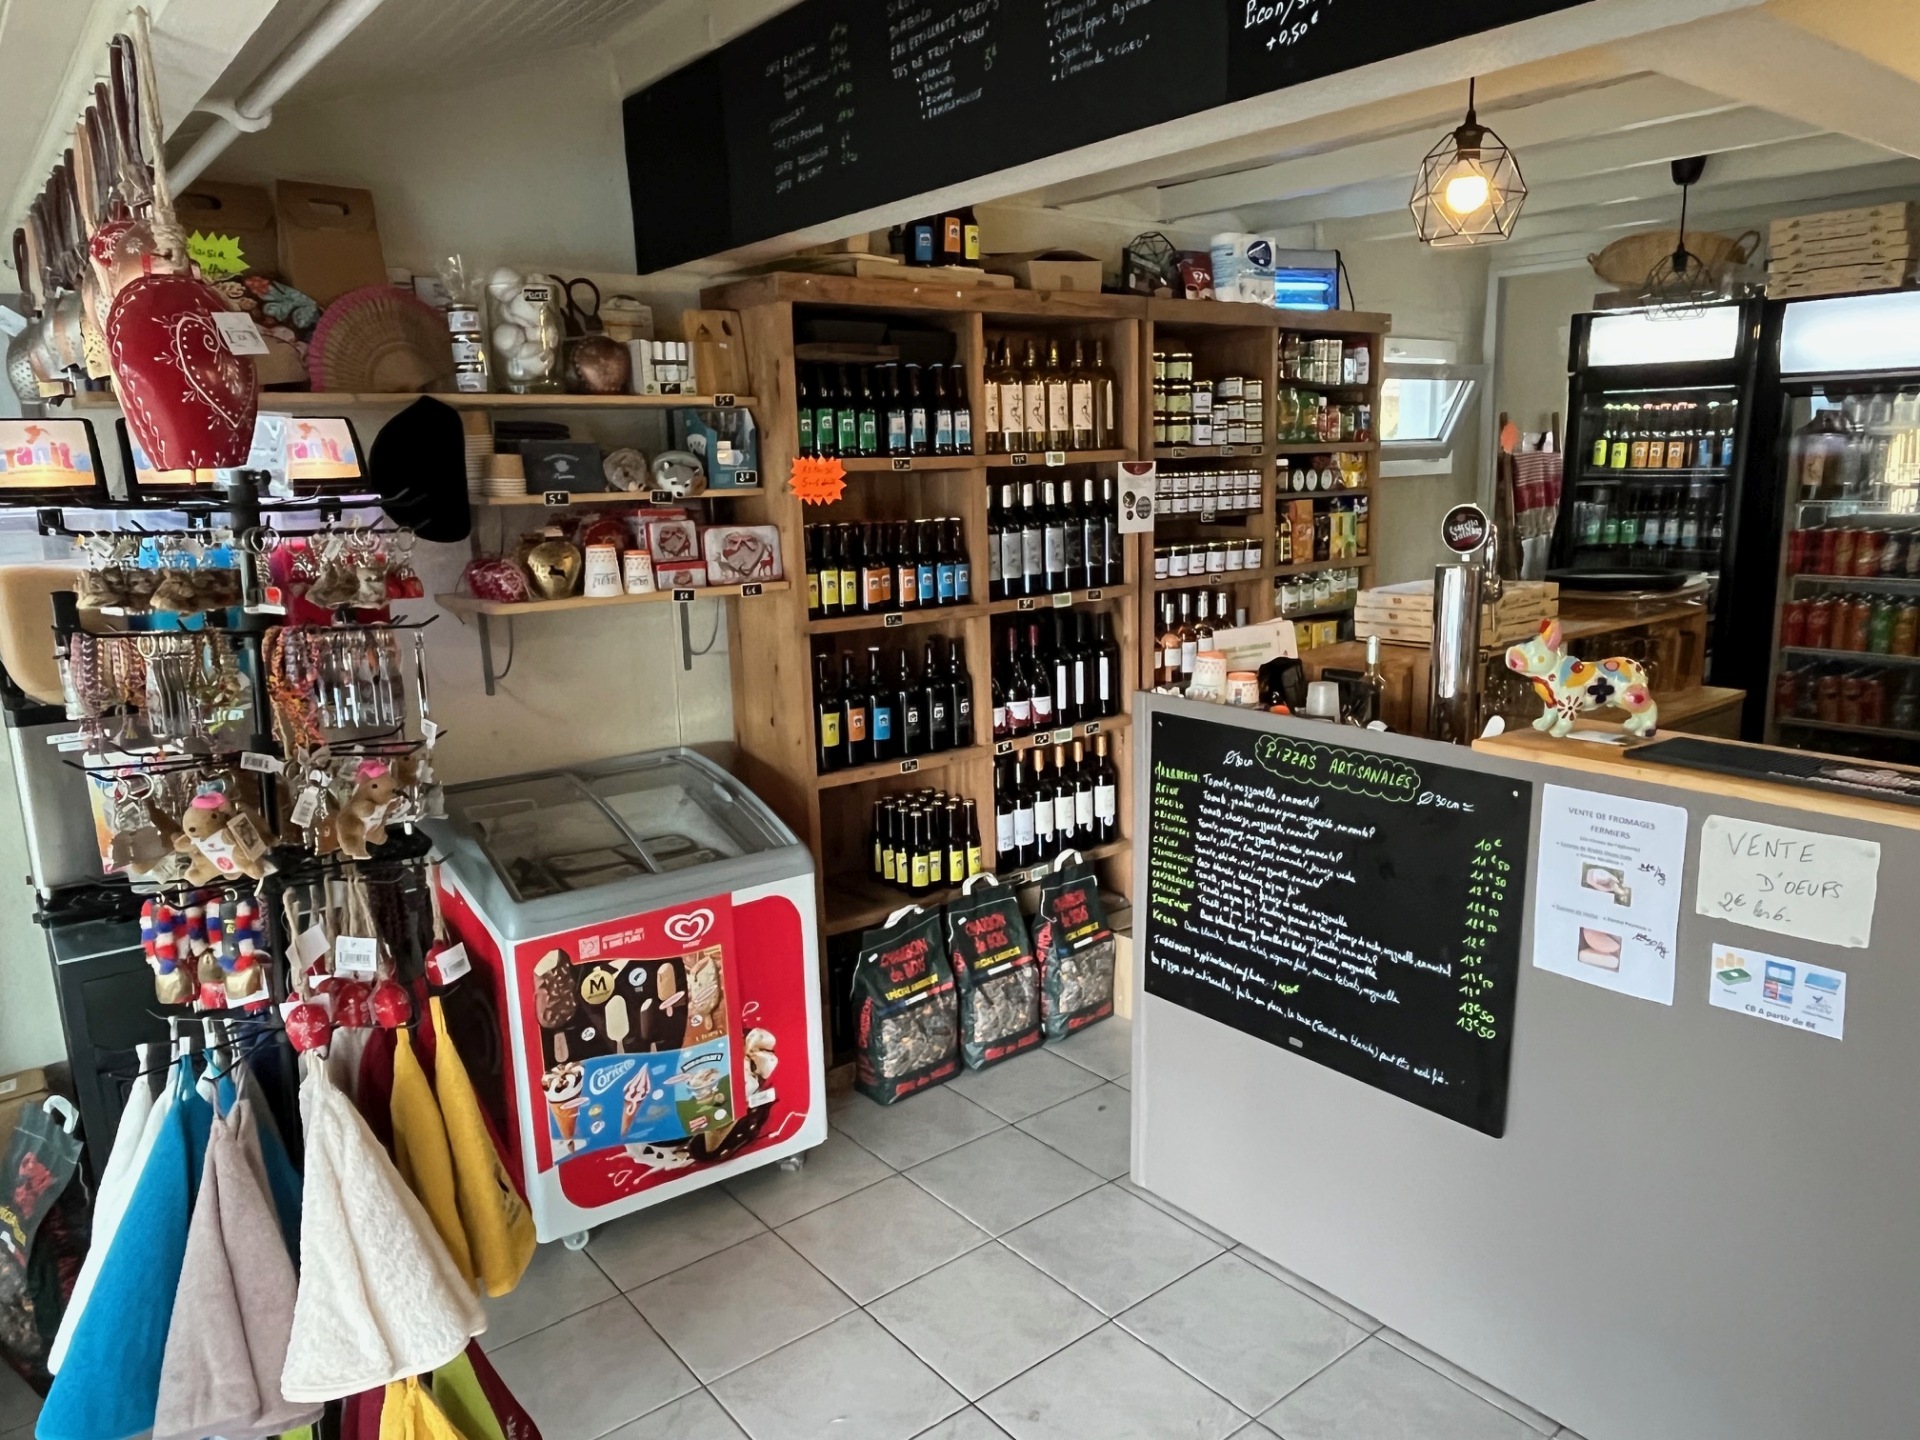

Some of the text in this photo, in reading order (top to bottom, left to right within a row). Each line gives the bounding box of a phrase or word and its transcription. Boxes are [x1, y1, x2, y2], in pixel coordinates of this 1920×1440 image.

[1264, 741, 1412, 789] PIZZAS ARTISANALES
[1568, 806, 1656, 831] VENTE DE FROMAGES
[1590, 824, 1632, 840] FERMIERS
[1727, 832, 1815, 863] VENTE
[1756, 872, 1843, 899] D'OEUFS
[1718, 891, 1747, 912] 2€
[1766, 1010, 1791, 1022] partir
[1792, 1017, 1804, 1026] de
